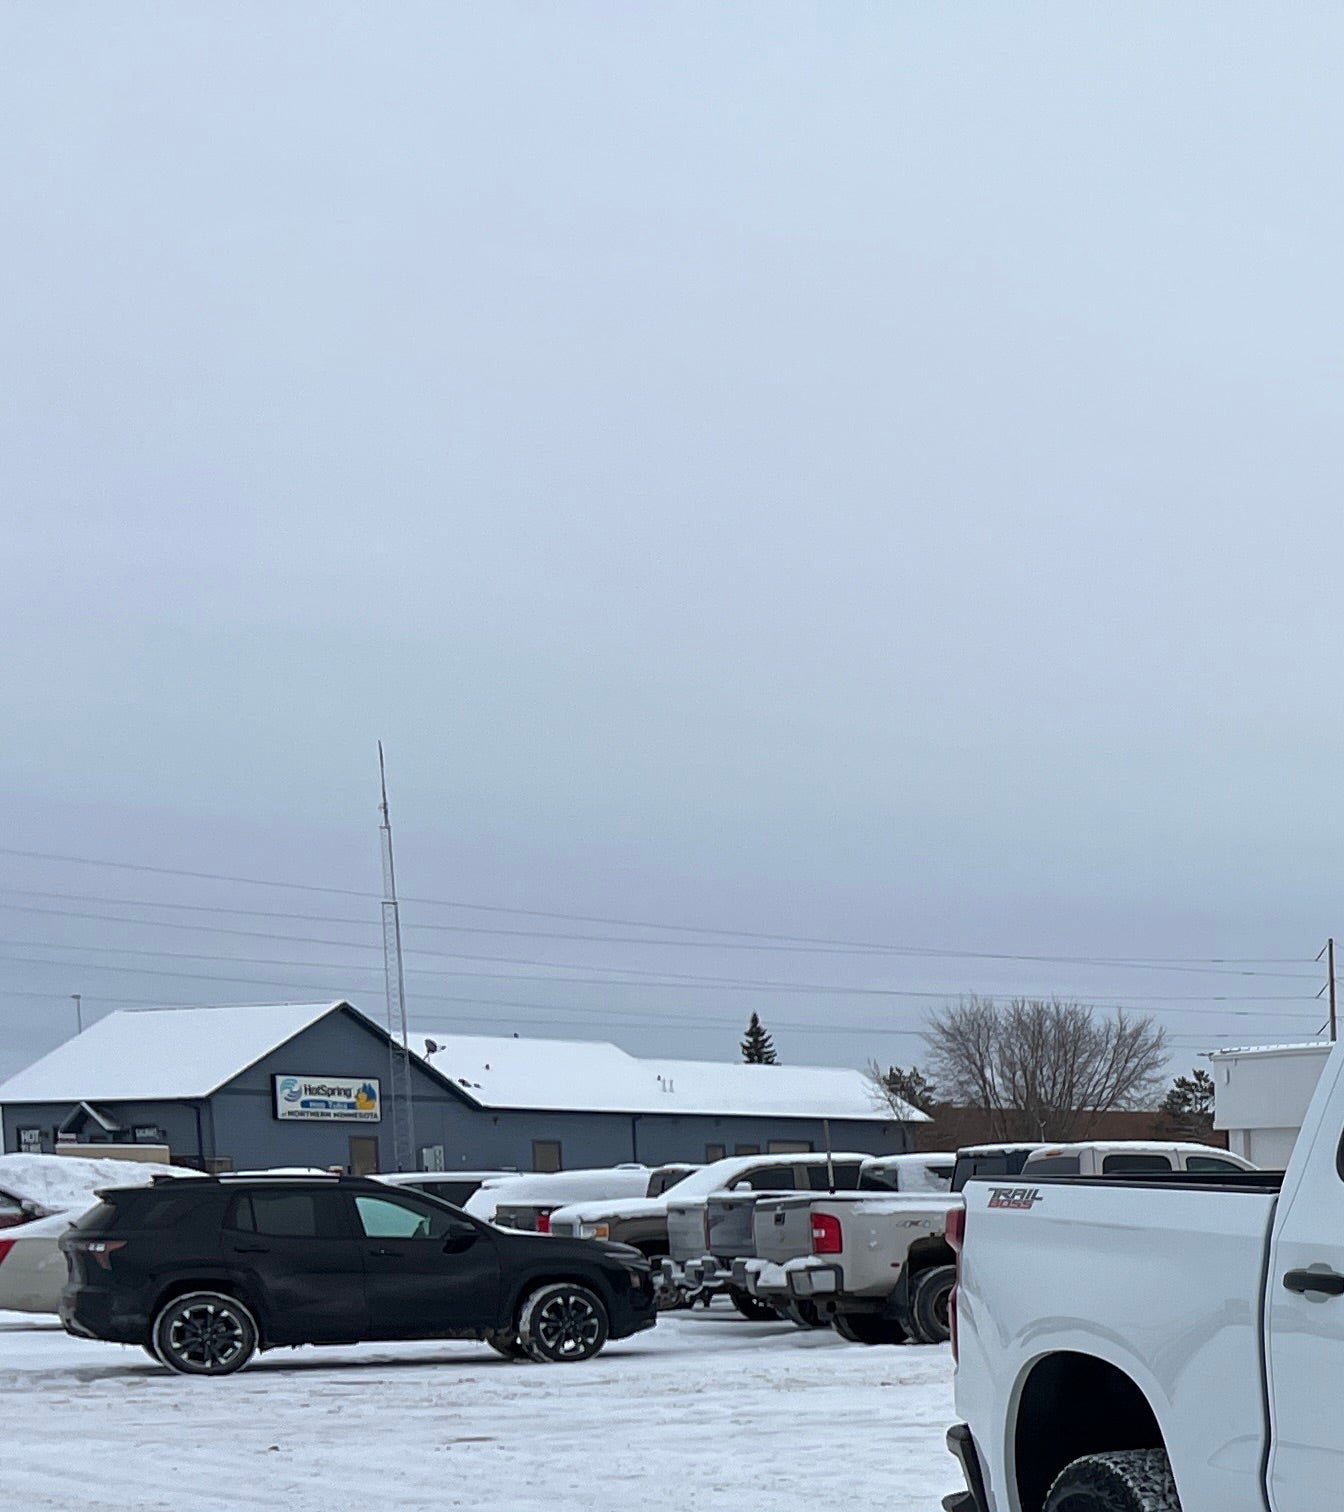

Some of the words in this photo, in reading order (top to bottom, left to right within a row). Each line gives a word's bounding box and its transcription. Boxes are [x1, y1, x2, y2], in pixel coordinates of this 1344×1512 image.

[303, 1084, 352, 1099] HotSpring
[988, 1187, 1044, 1201] TRAIL
[987, 1199, 1035, 1210] BOSS
